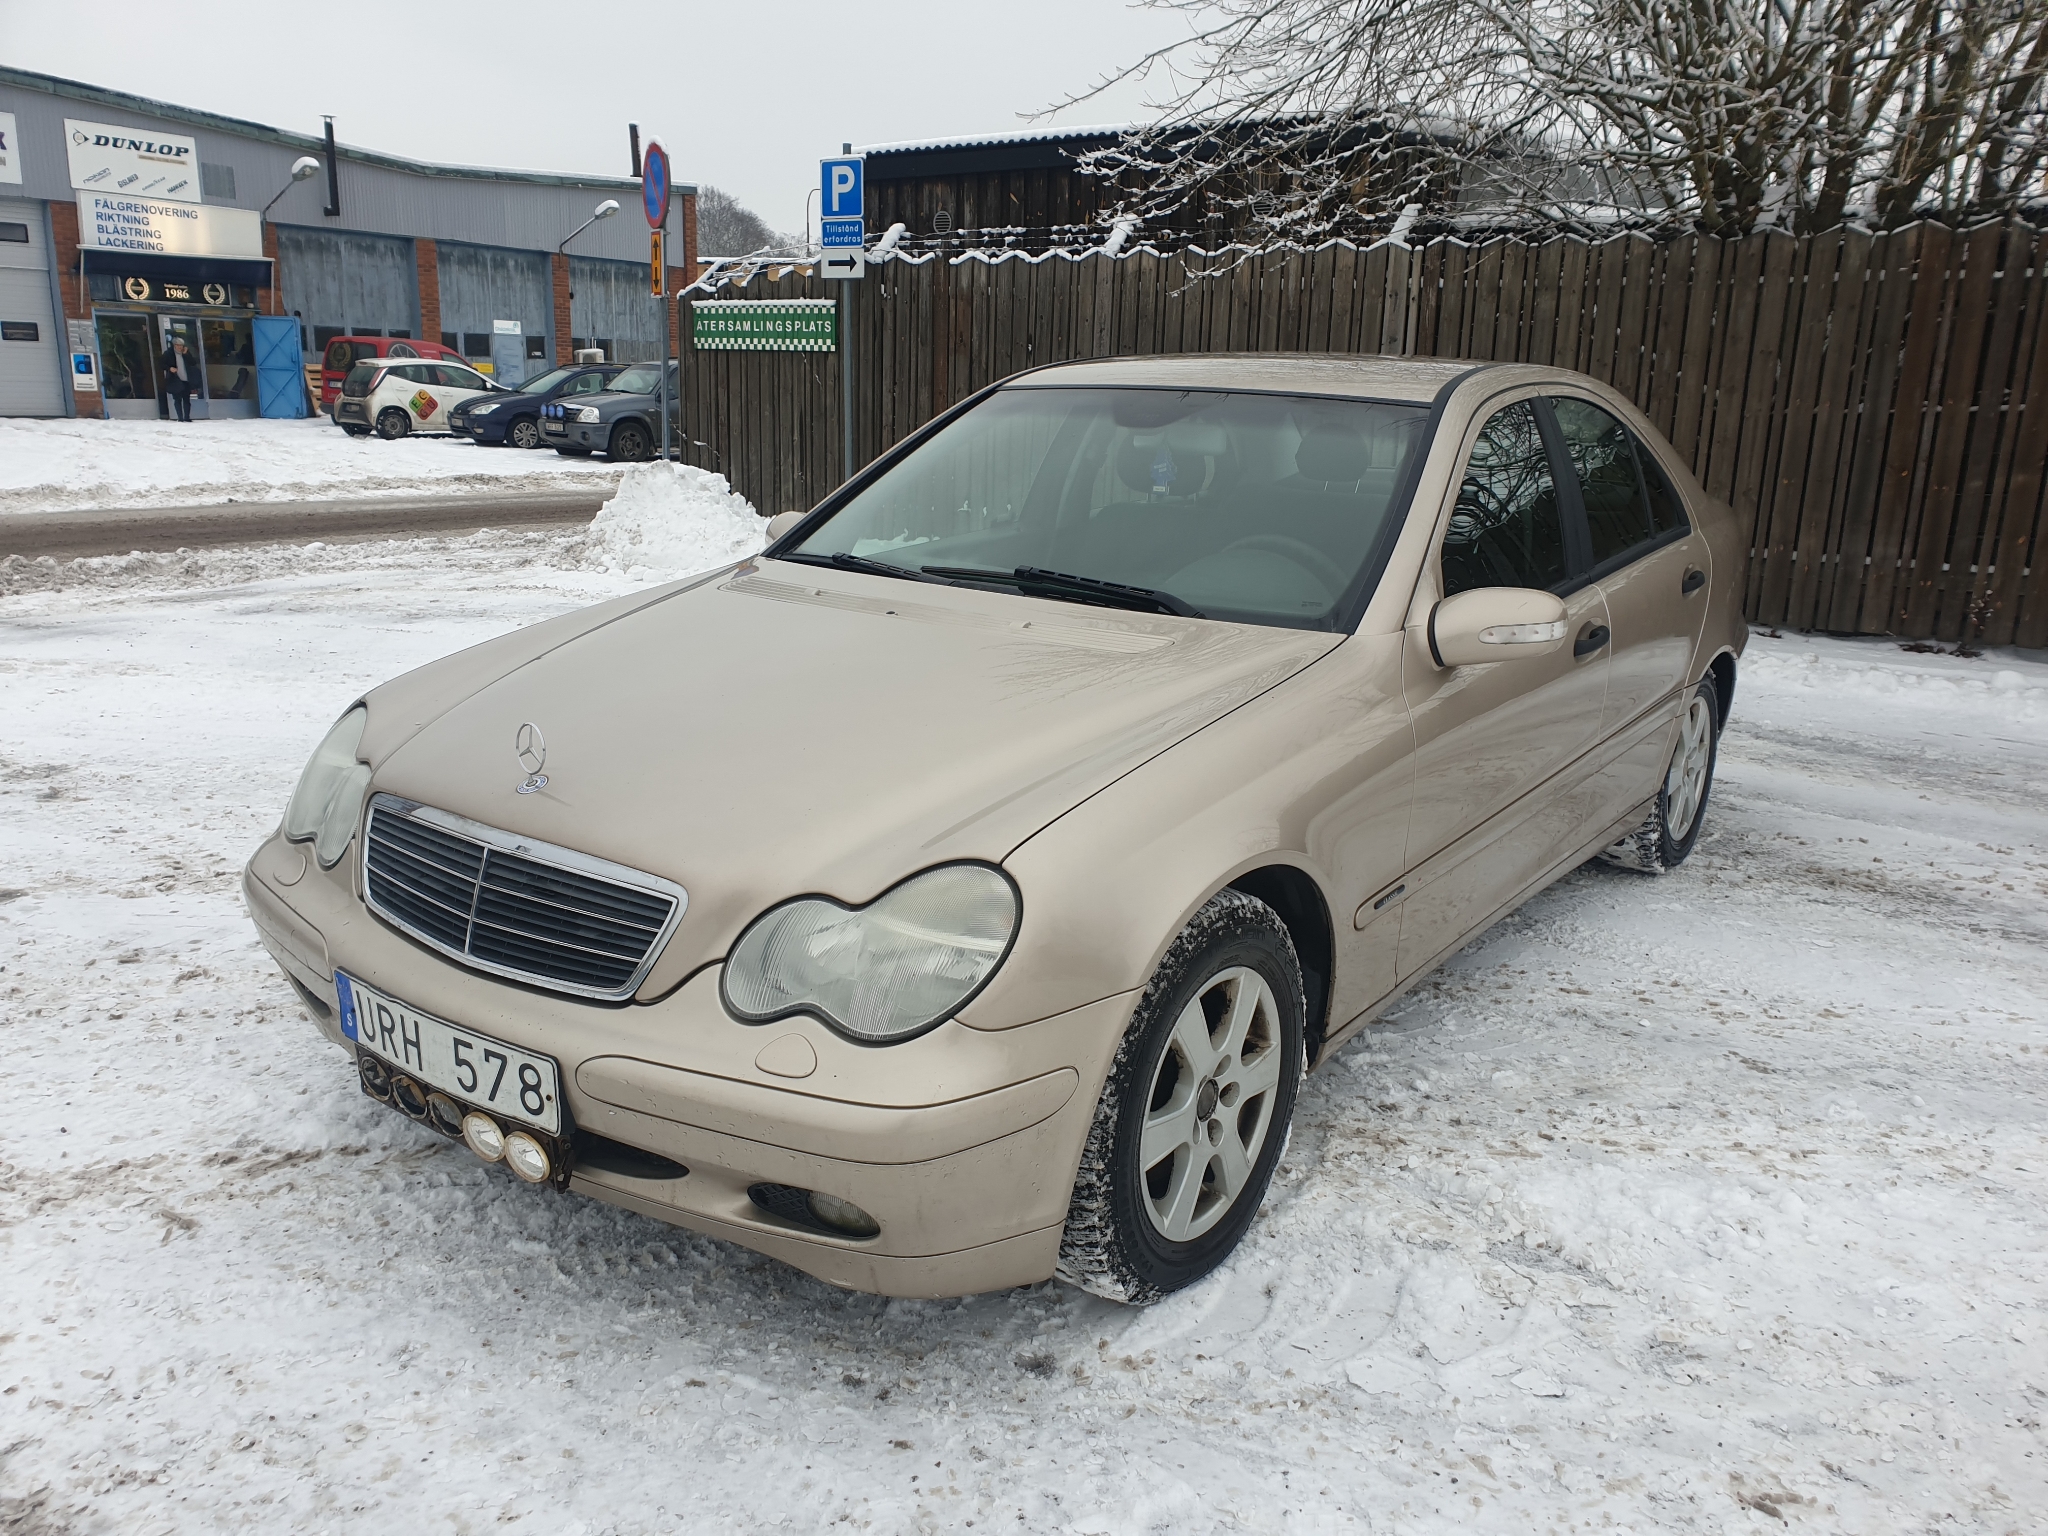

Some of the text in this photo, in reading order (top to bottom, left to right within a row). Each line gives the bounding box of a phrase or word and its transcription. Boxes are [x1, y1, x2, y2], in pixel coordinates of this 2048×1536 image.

[92, 134, 190, 157] DUNLOP
[831, 165, 856, 212] P
[94, 197, 198, 219] FÄLGRENOVERING
[95, 211, 150, 226] RIKTNING
[96, 223, 162, 239] BLÄSTRING
[825, 224, 859, 233] Tillstånd
[97, 236, 164, 252] LACKERING
[823, 234, 862, 244] erfordras
[165, 288, 190, 299] 1986
[696, 318, 832, 332] ÅTERSAMLINGSPLATS
[346, 1013, 353, 1027] S
[355, 990, 545, 1116] URH 578
